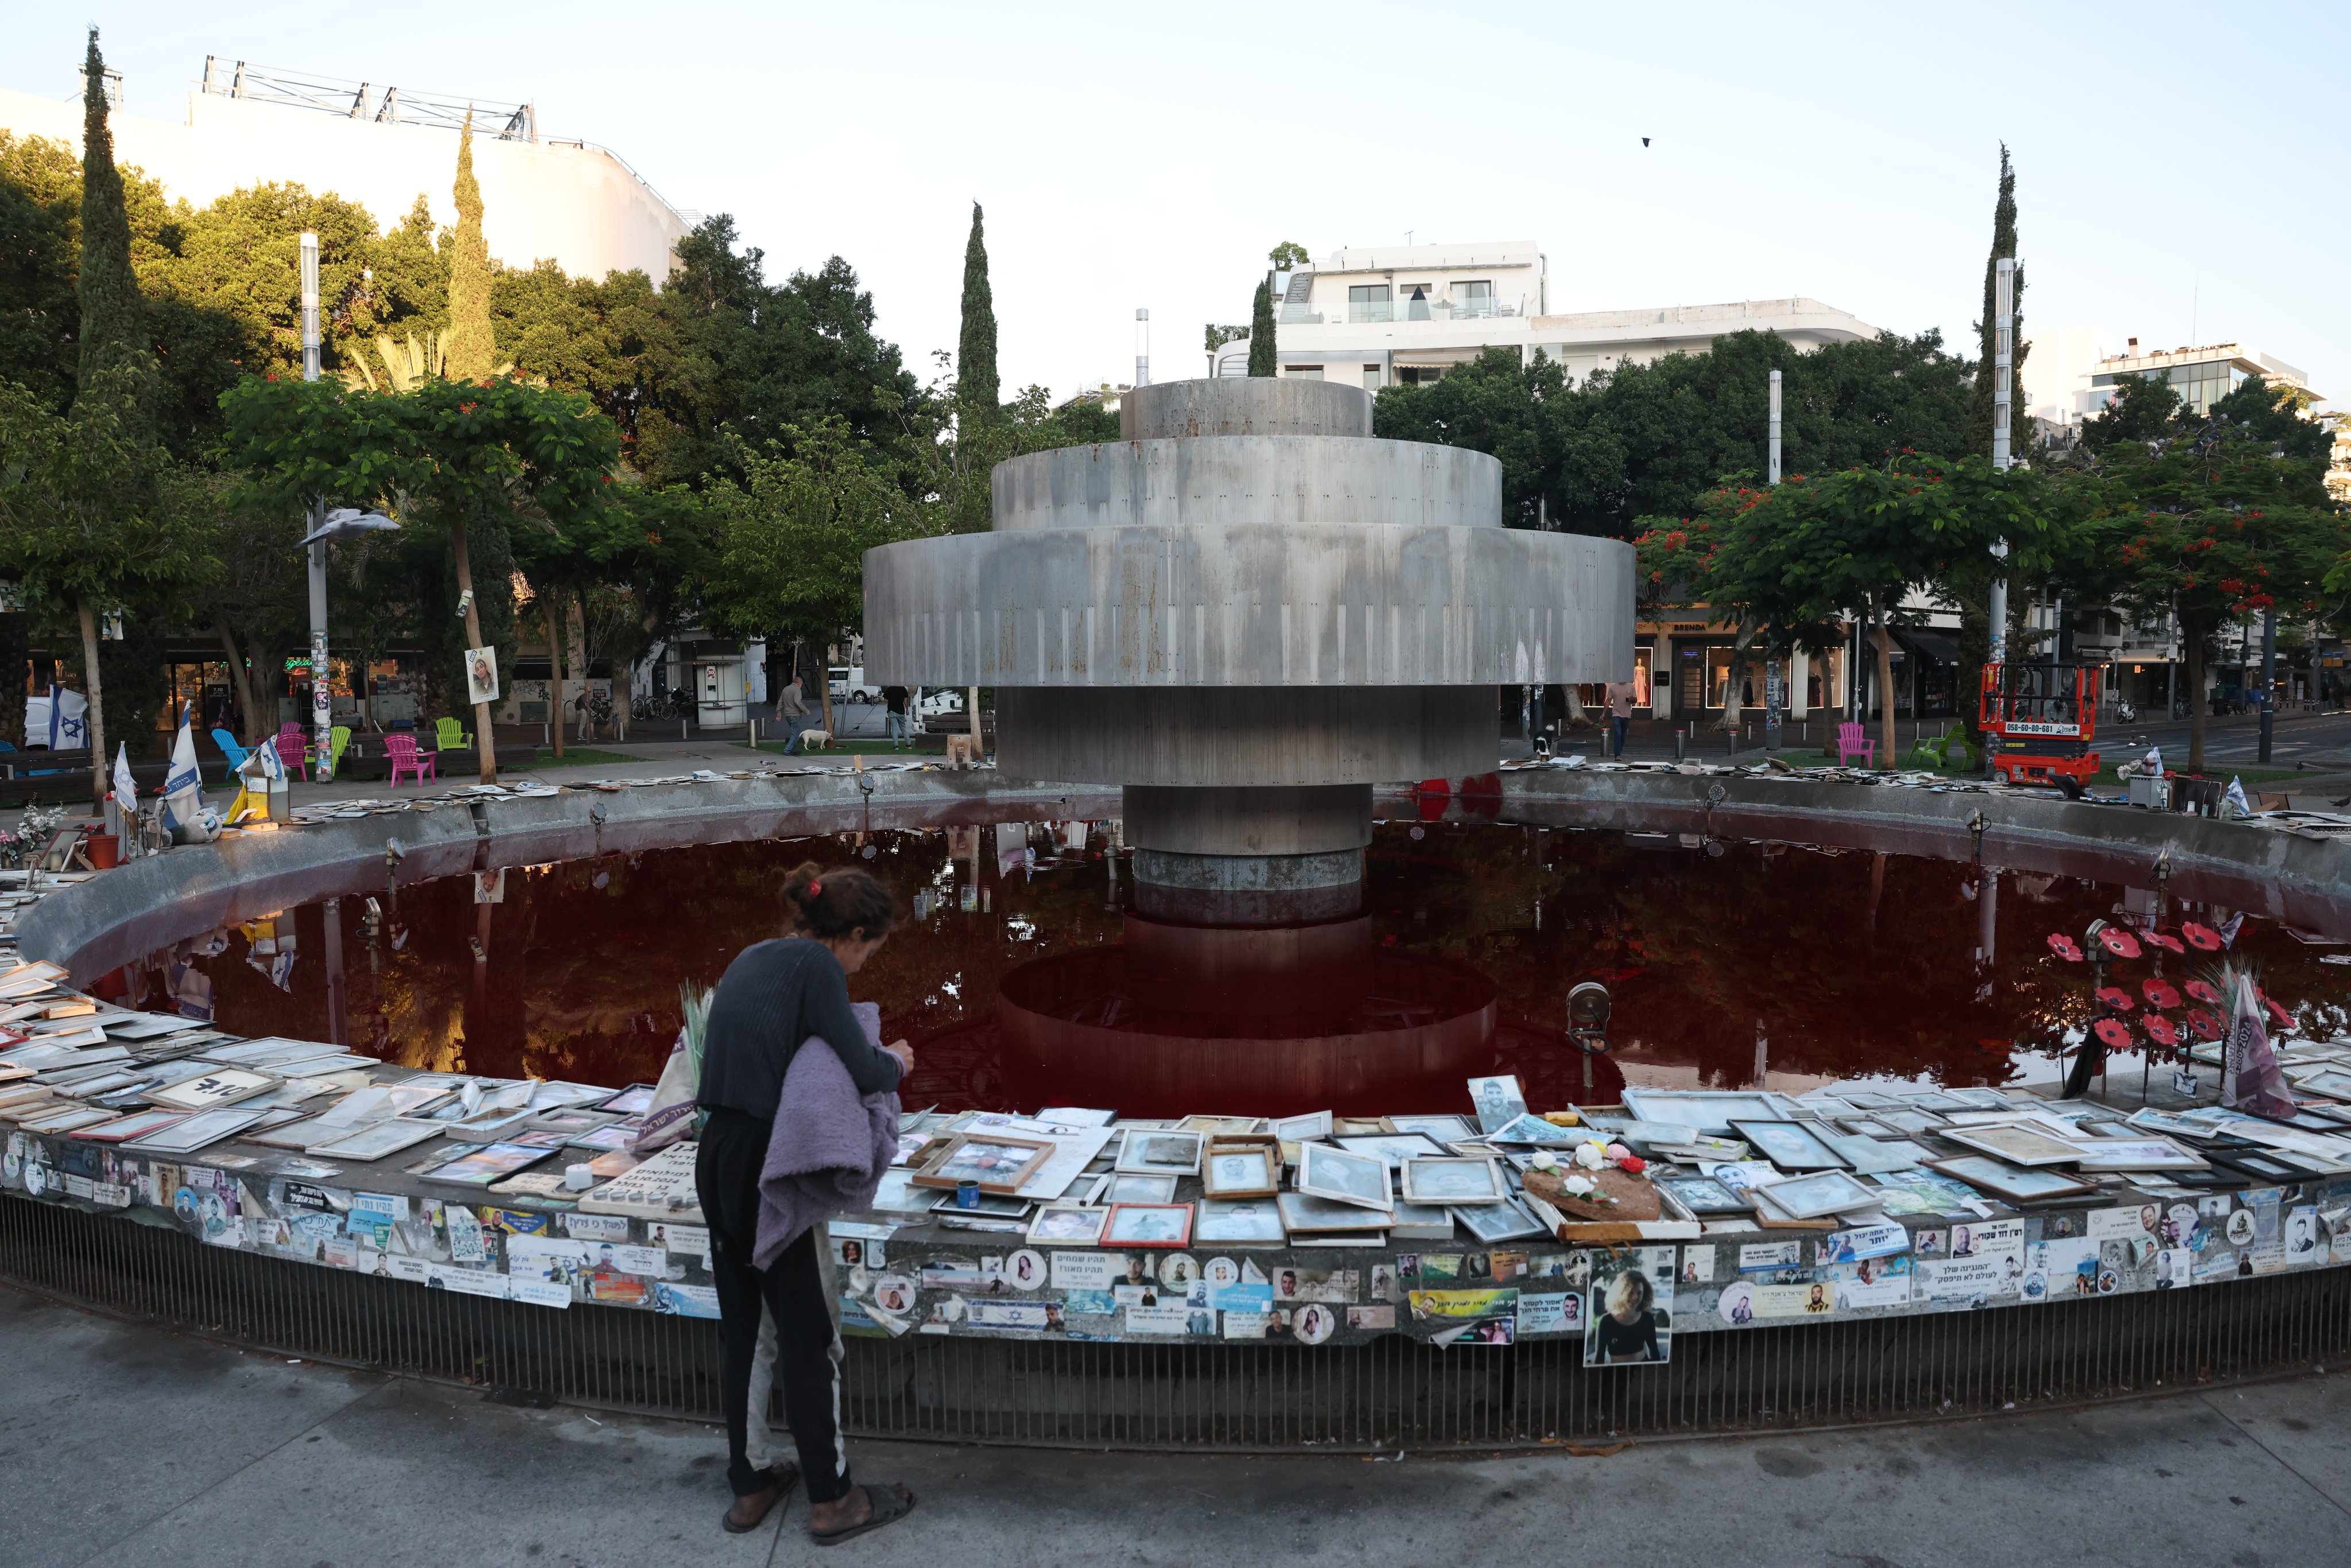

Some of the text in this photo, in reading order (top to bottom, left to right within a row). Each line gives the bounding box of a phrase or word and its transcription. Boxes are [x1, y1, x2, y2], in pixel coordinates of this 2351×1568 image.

[2007, 724, 2053, 733] 058-60-80-681
[172, 777, 190, 789] ביחד
[193, 1078, 248, 1096] 7.10
[641, 1114, 669, 1134] ישראל
[1869, 1235, 1888, 1245] יותר
[1978, 1232, 1996, 1240] שקורי
[633, 1260, 653, 1268] לחייך
[1060, 1264, 1082, 1272] מאור!
[1943, 1263, 1991, 1275] "המנגינה שלך
[1935, 1270, 1997, 1284] לעולם לא תיפסק"
[1523, 1299, 1543, 1307] לקטוף
